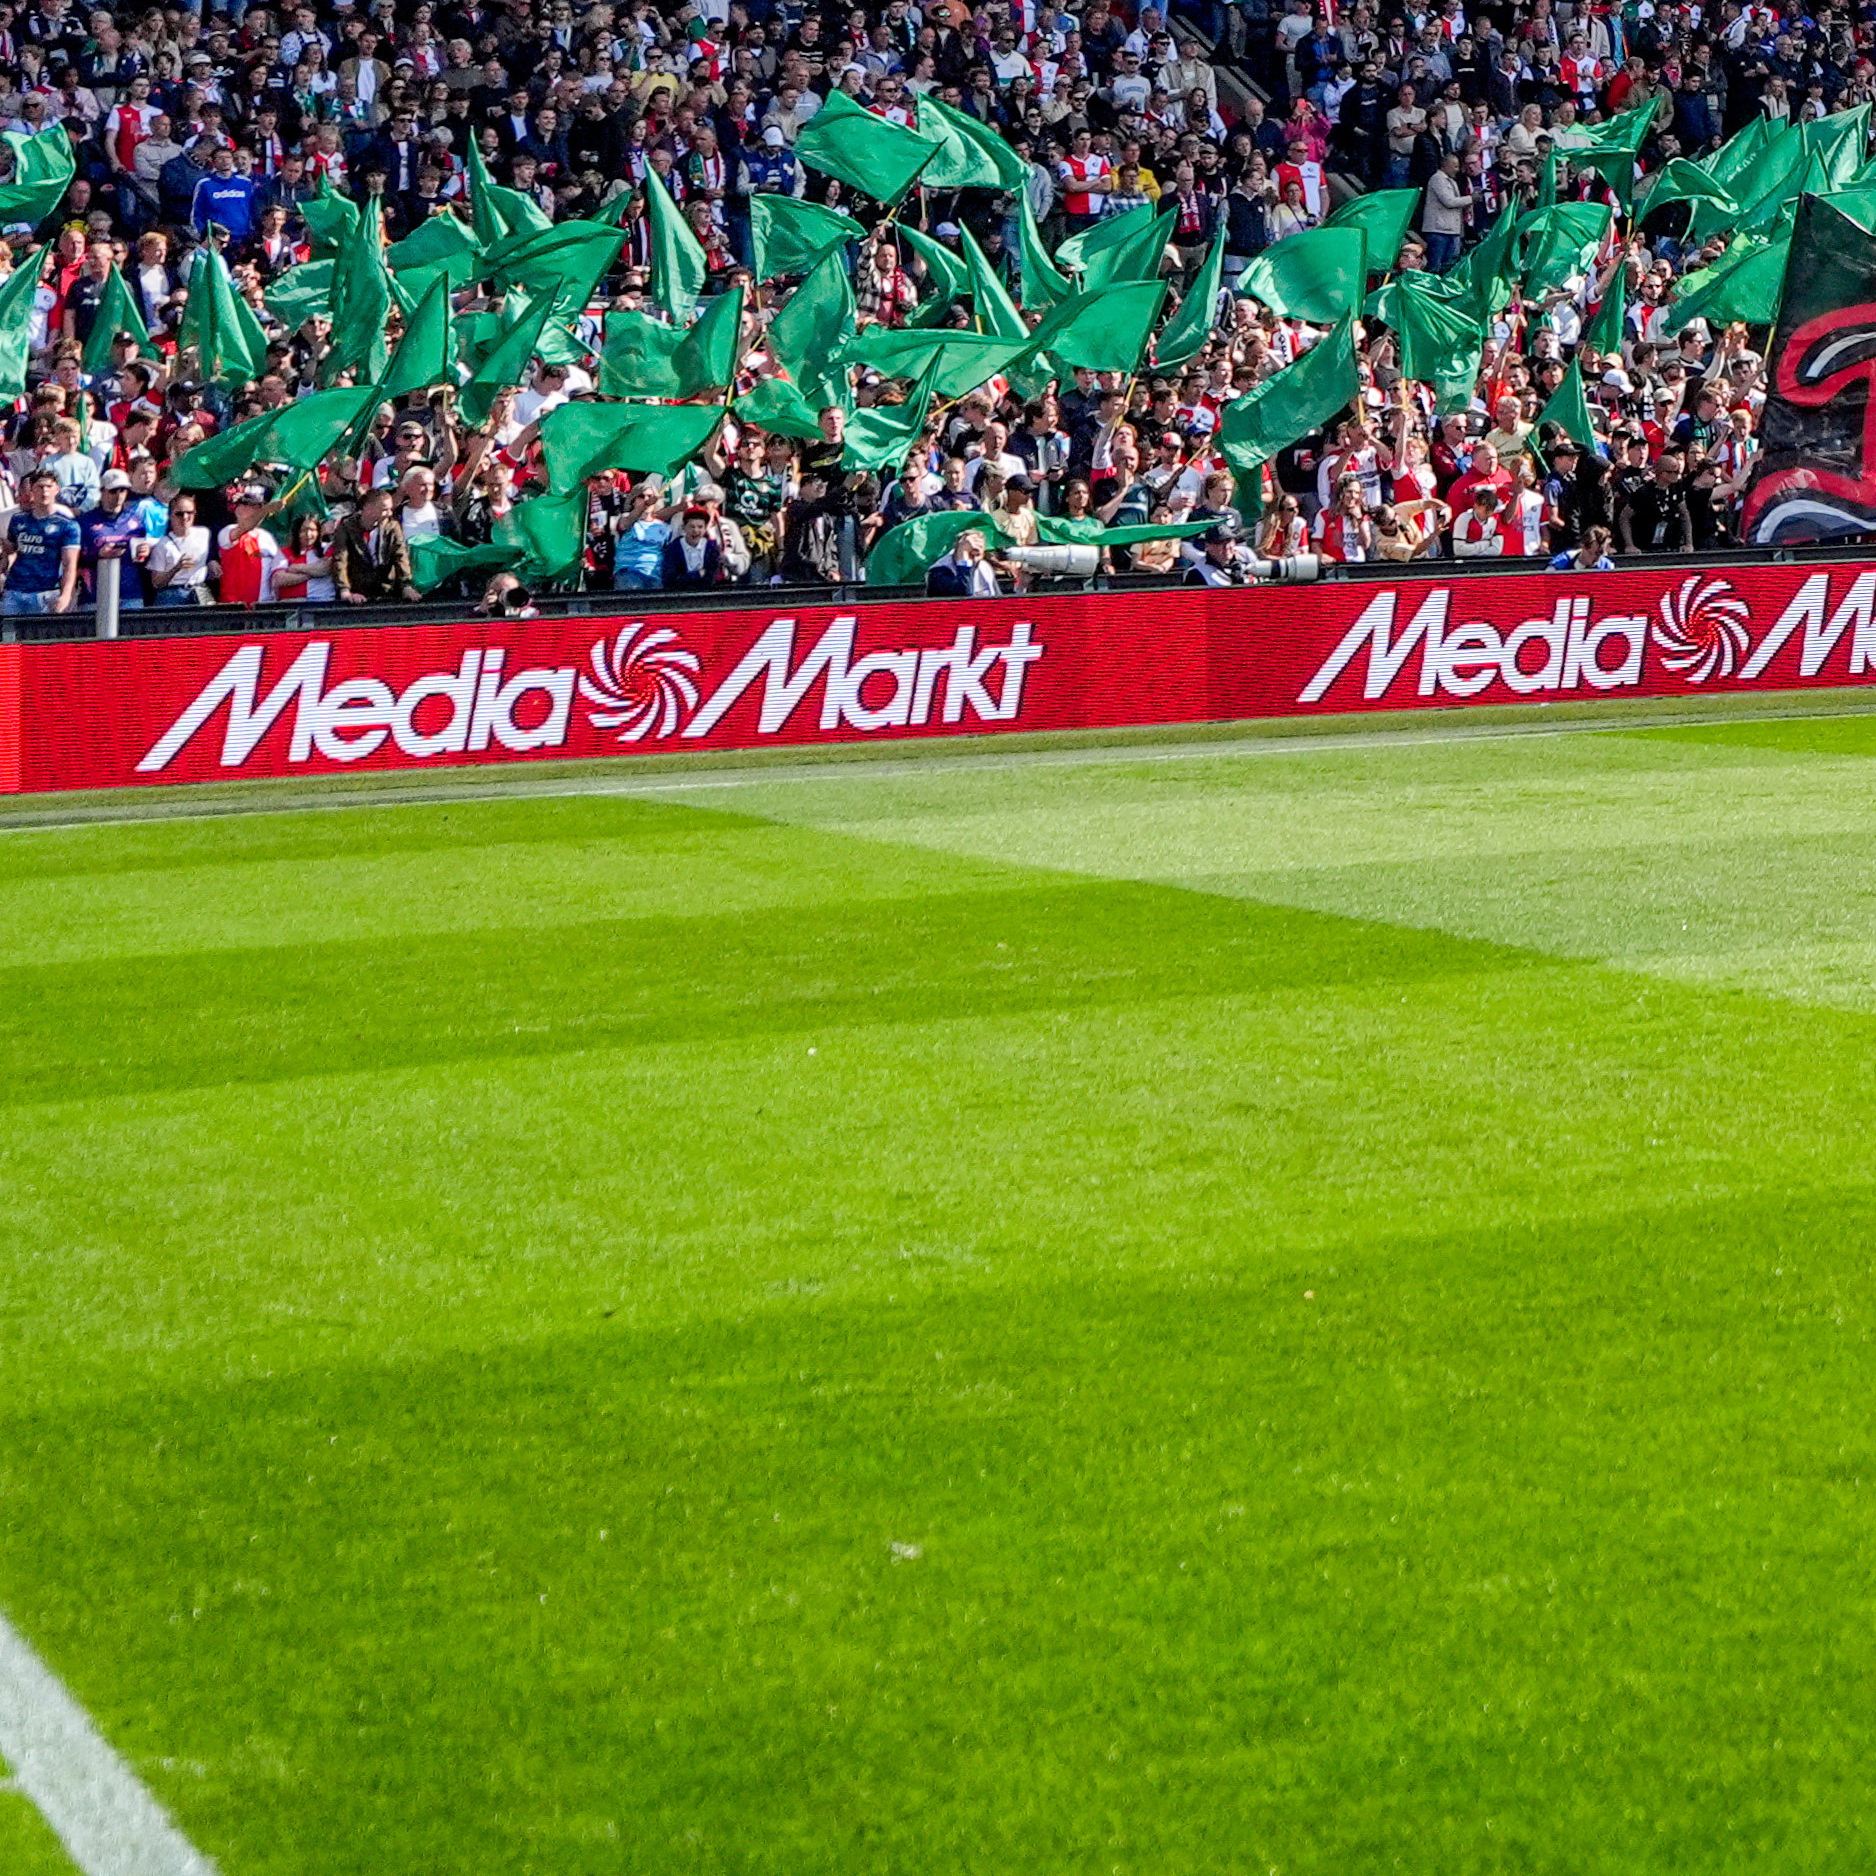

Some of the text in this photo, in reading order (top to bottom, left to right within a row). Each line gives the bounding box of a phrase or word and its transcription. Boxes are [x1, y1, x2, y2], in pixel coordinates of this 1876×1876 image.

[212, 189, 246, 199] adidas
[136, 616, 1043, 772] Media Markt
[1297, 588, 1648, 704] Media
